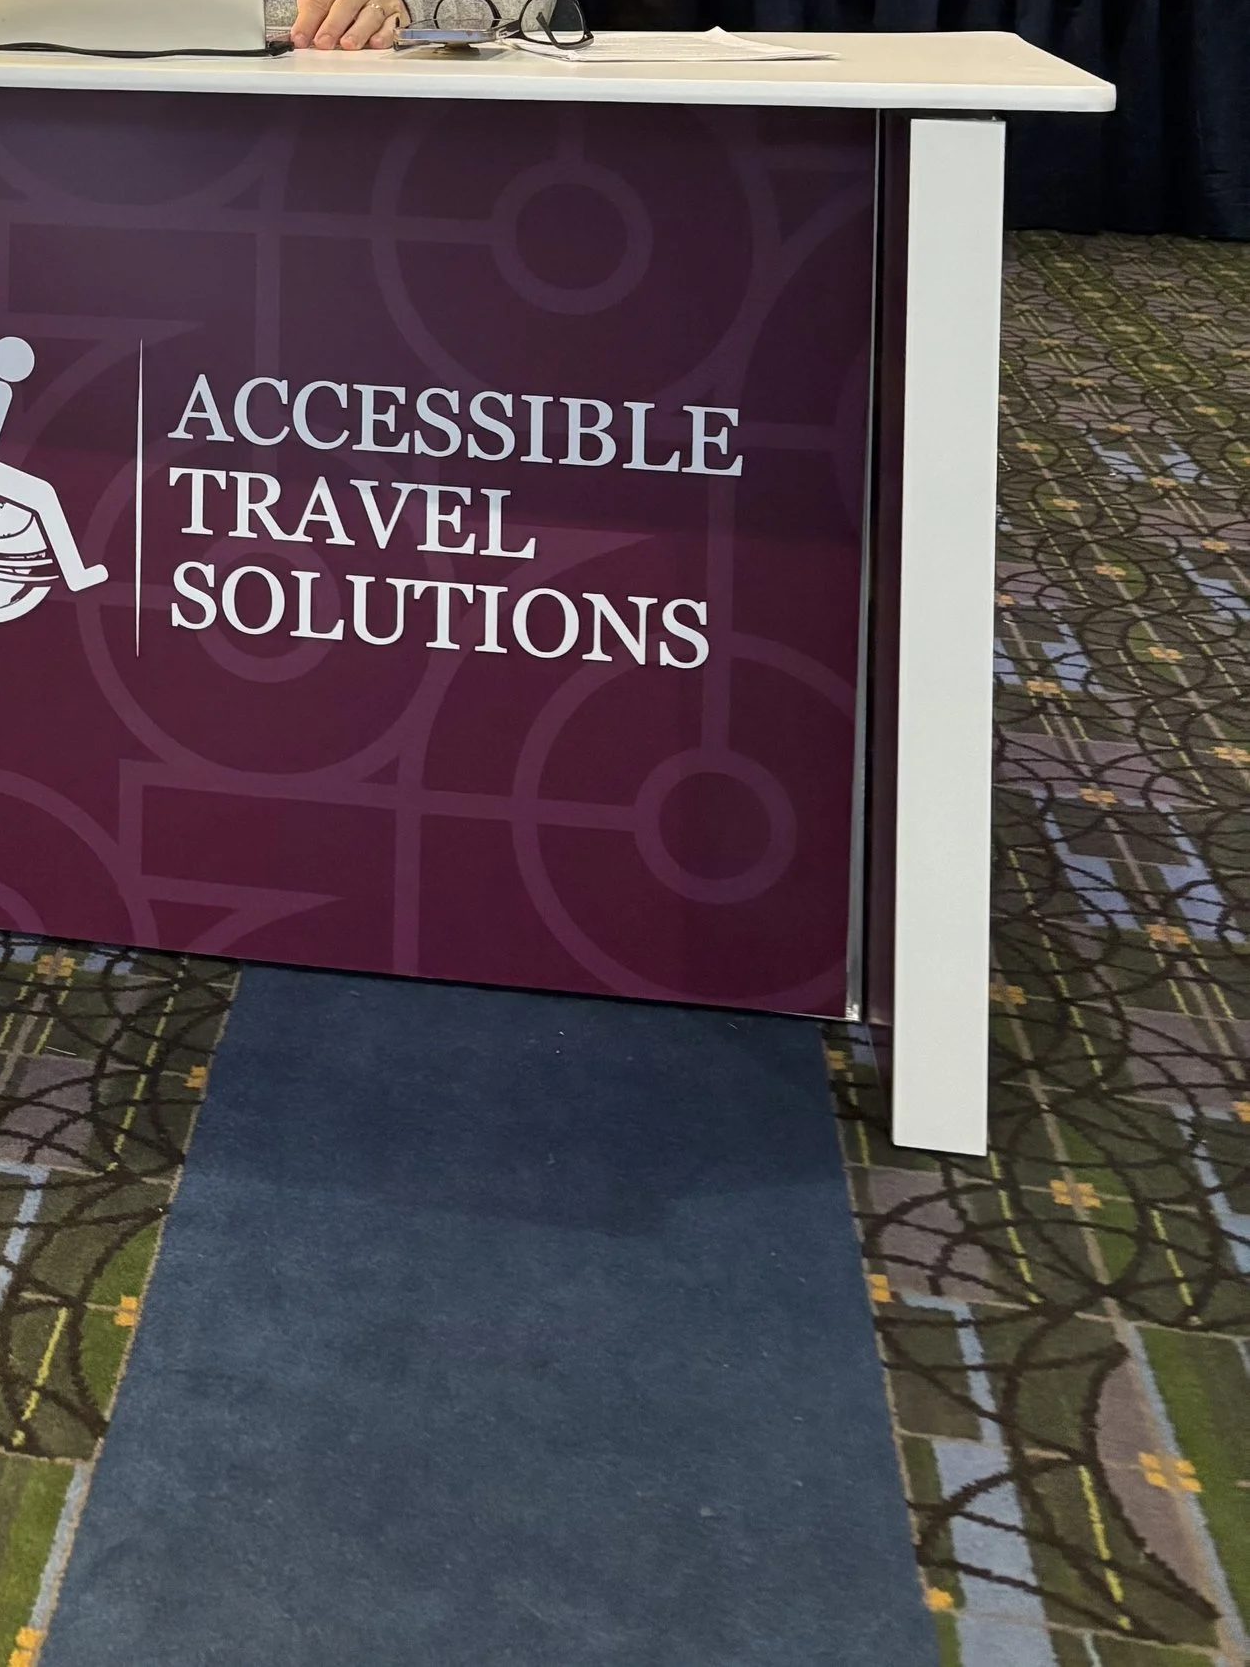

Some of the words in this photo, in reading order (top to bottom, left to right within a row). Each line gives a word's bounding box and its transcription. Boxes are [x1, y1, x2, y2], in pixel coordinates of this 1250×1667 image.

[167, 374, 744, 477] ACCESSIBLE
[169, 467, 536, 560] TRAVEL
[170, 561, 709, 669] SOLUTIONS
